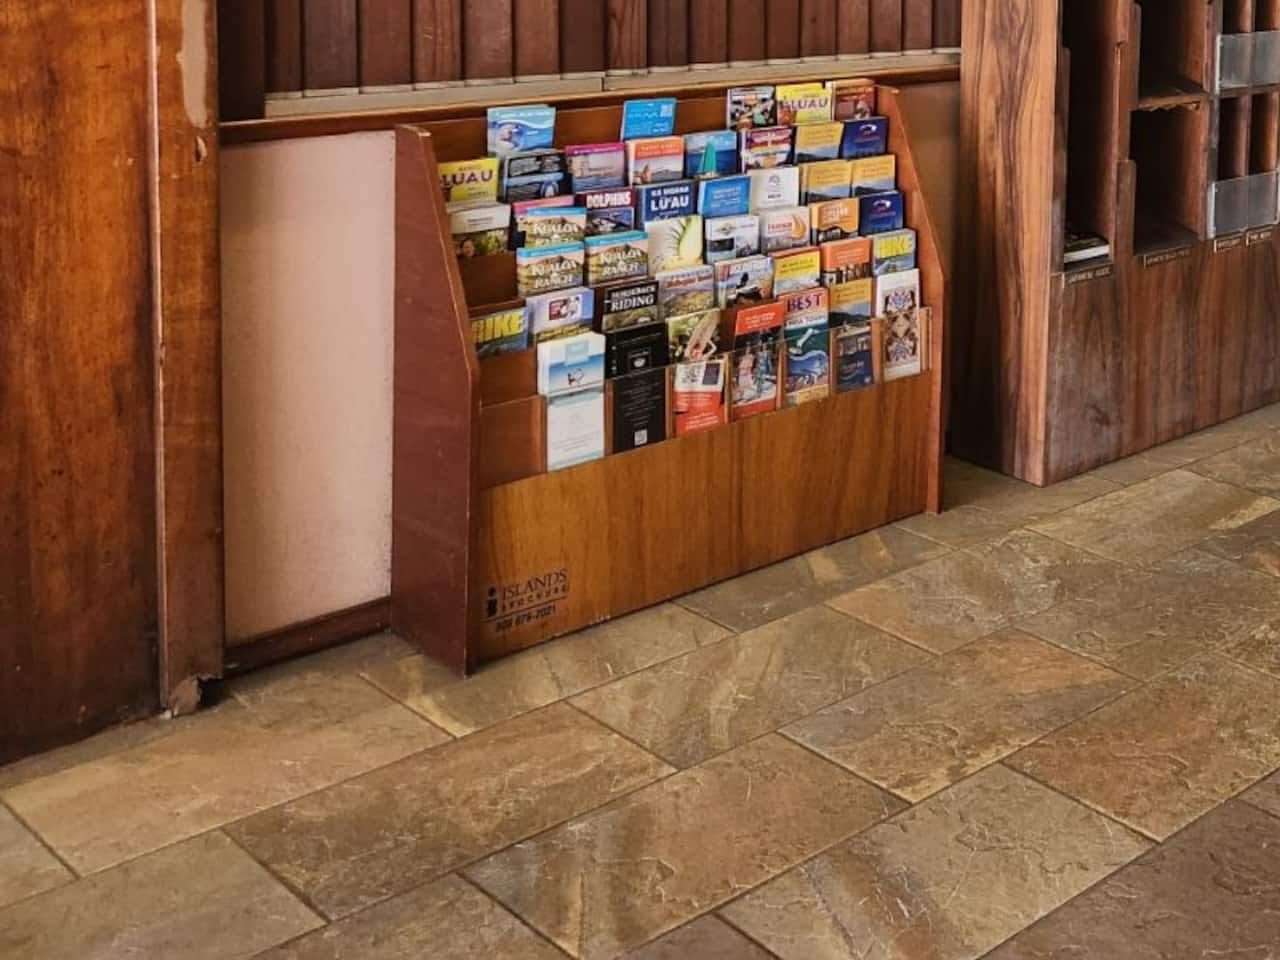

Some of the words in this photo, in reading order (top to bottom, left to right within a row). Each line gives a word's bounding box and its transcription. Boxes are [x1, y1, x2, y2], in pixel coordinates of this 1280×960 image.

[441, 169, 493, 188] LUAU
[586, 190, 632, 209] DOLPHINS
[611, 294, 654, 312] RIDING
[787, 294, 822, 313] BEST
